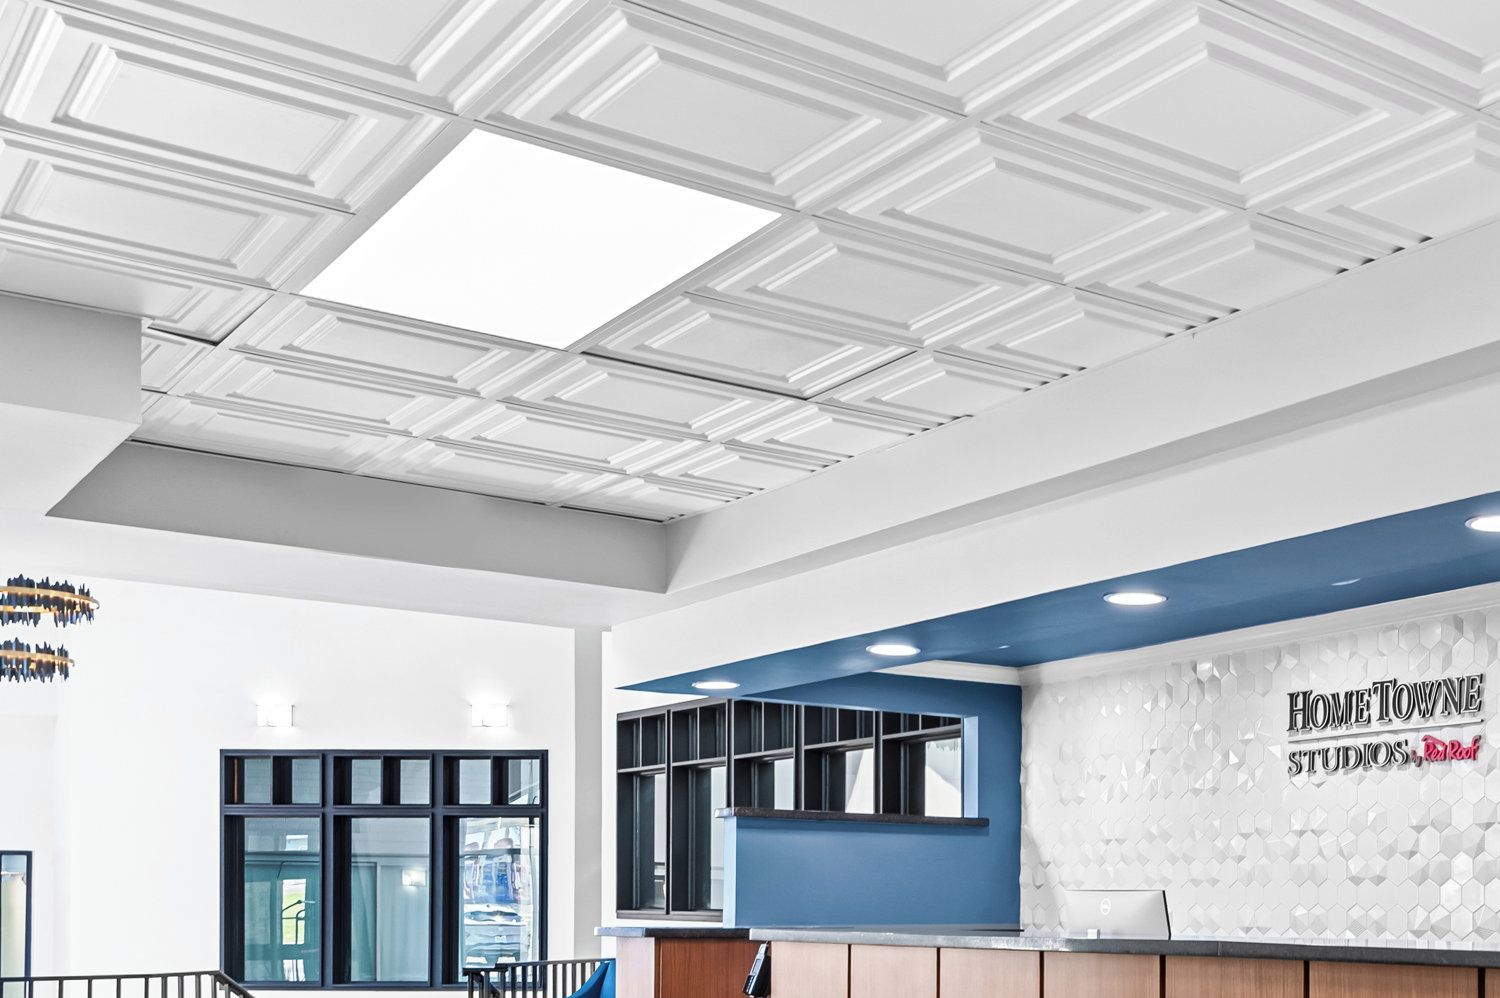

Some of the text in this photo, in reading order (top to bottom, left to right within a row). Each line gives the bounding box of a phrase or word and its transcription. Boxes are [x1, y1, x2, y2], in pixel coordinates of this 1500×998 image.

[1288, 739, 1408, 775] STUDIOS
[1422, 735, 1448, 762] Red
[1448, 735, 1481, 761] Roof
